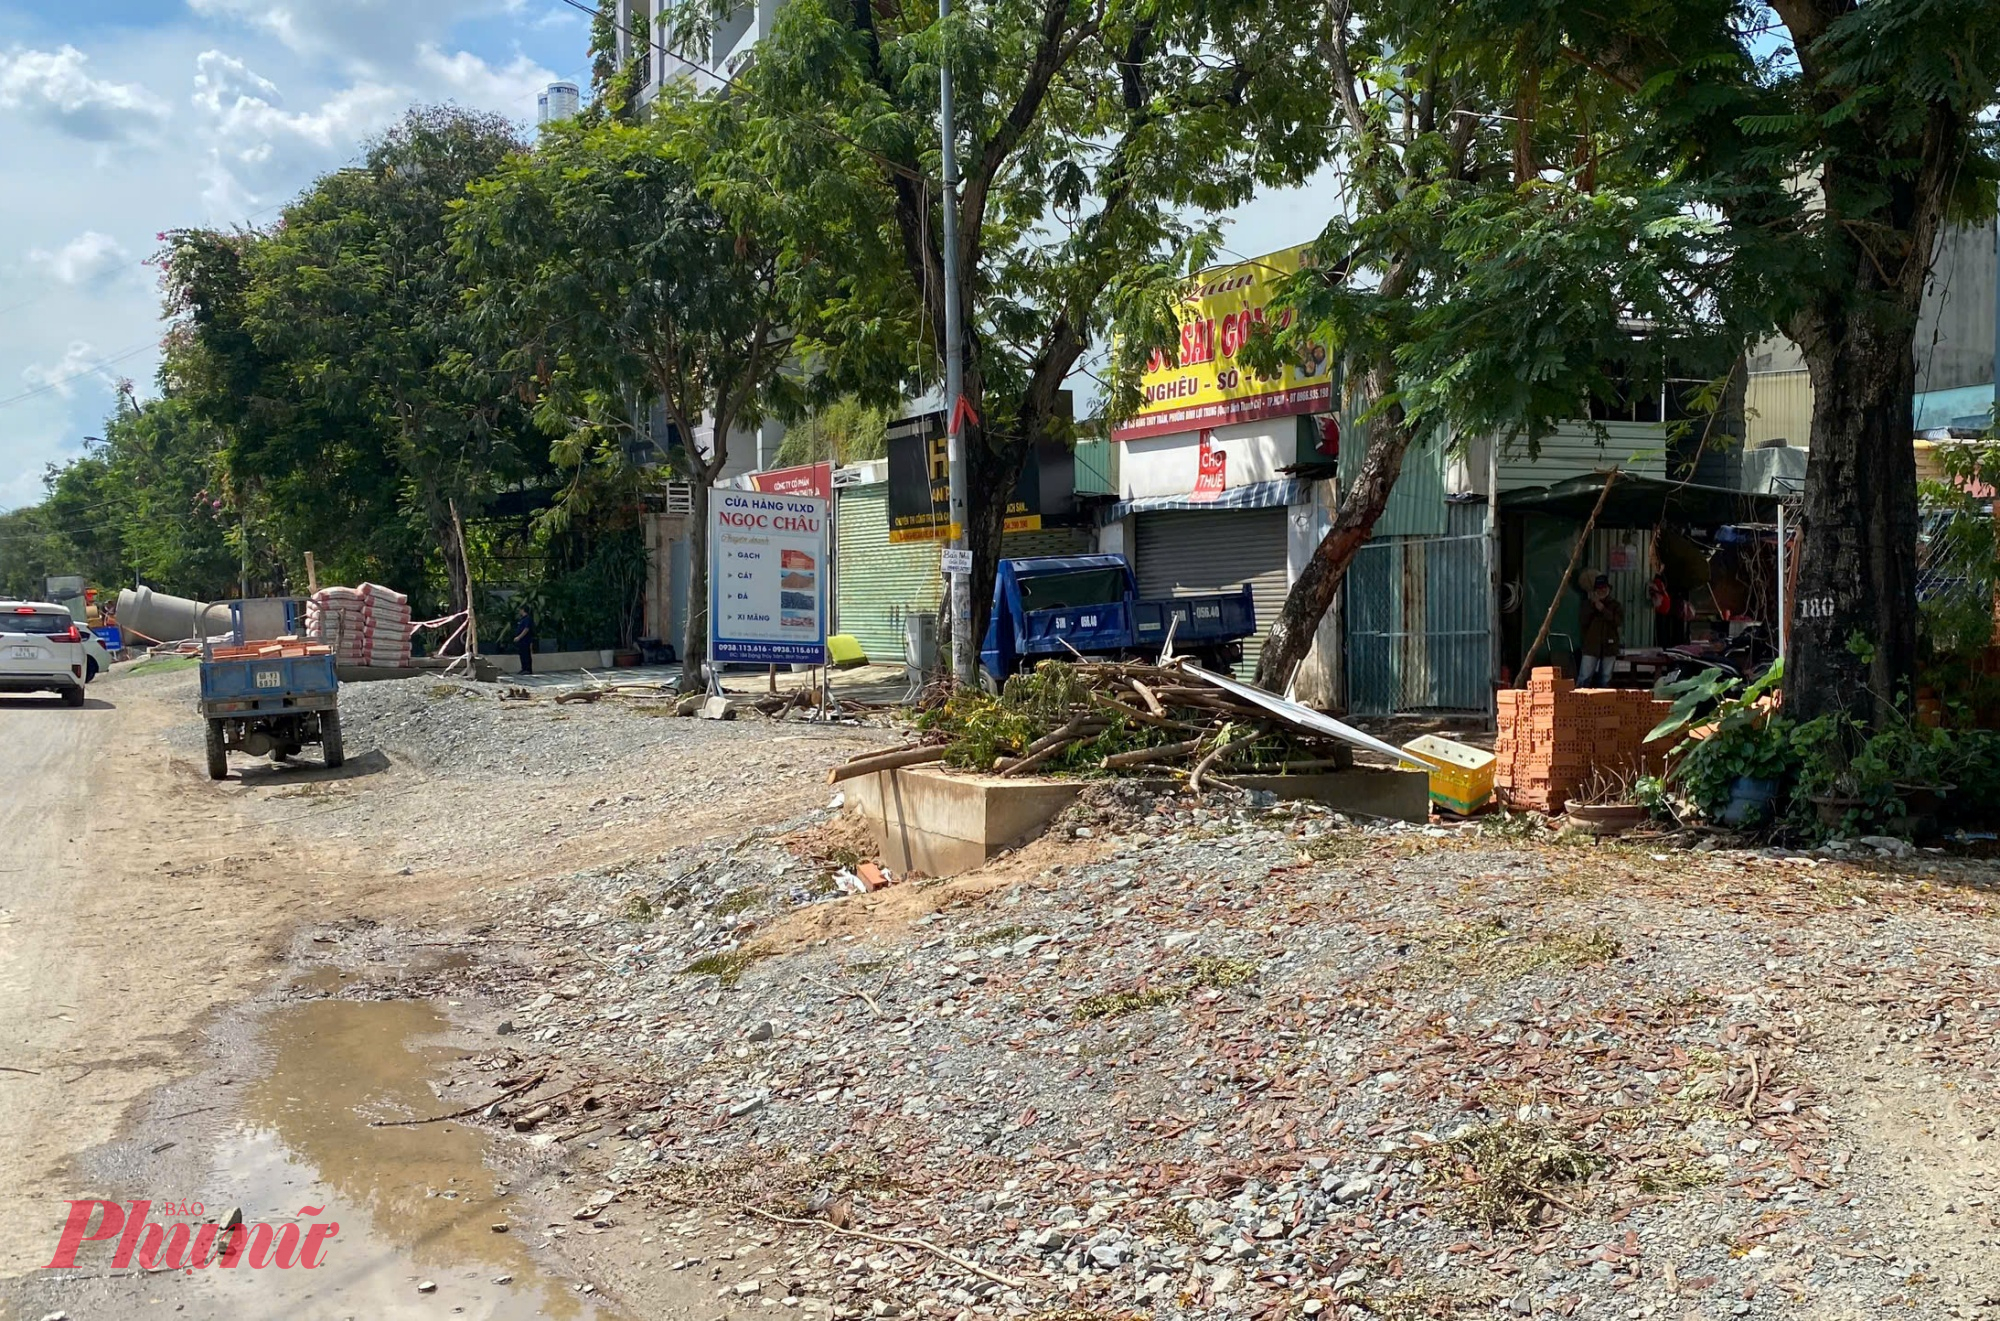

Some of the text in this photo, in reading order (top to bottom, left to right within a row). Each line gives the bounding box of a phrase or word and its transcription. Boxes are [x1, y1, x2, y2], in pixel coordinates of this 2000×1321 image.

[1221, 300, 1264, 358] GÒ
[1146, 376, 1198, 402] NGHÊU
[1217, 365, 1239, 391] SÒ
[1202, 452, 1222, 468] CHO
[1199, 469, 1223, 488] THUÊ
[725, 496, 814, 513] CỬA HÀNG VLXD
[719, 511, 820, 532] NGỌC CHÂU
[737, 551, 760, 560] GẠCH
[737, 571, 752, 579] CÁT
[1801, 597, 1834, 617] 180
[747, 613, 770, 621] MĂNG
